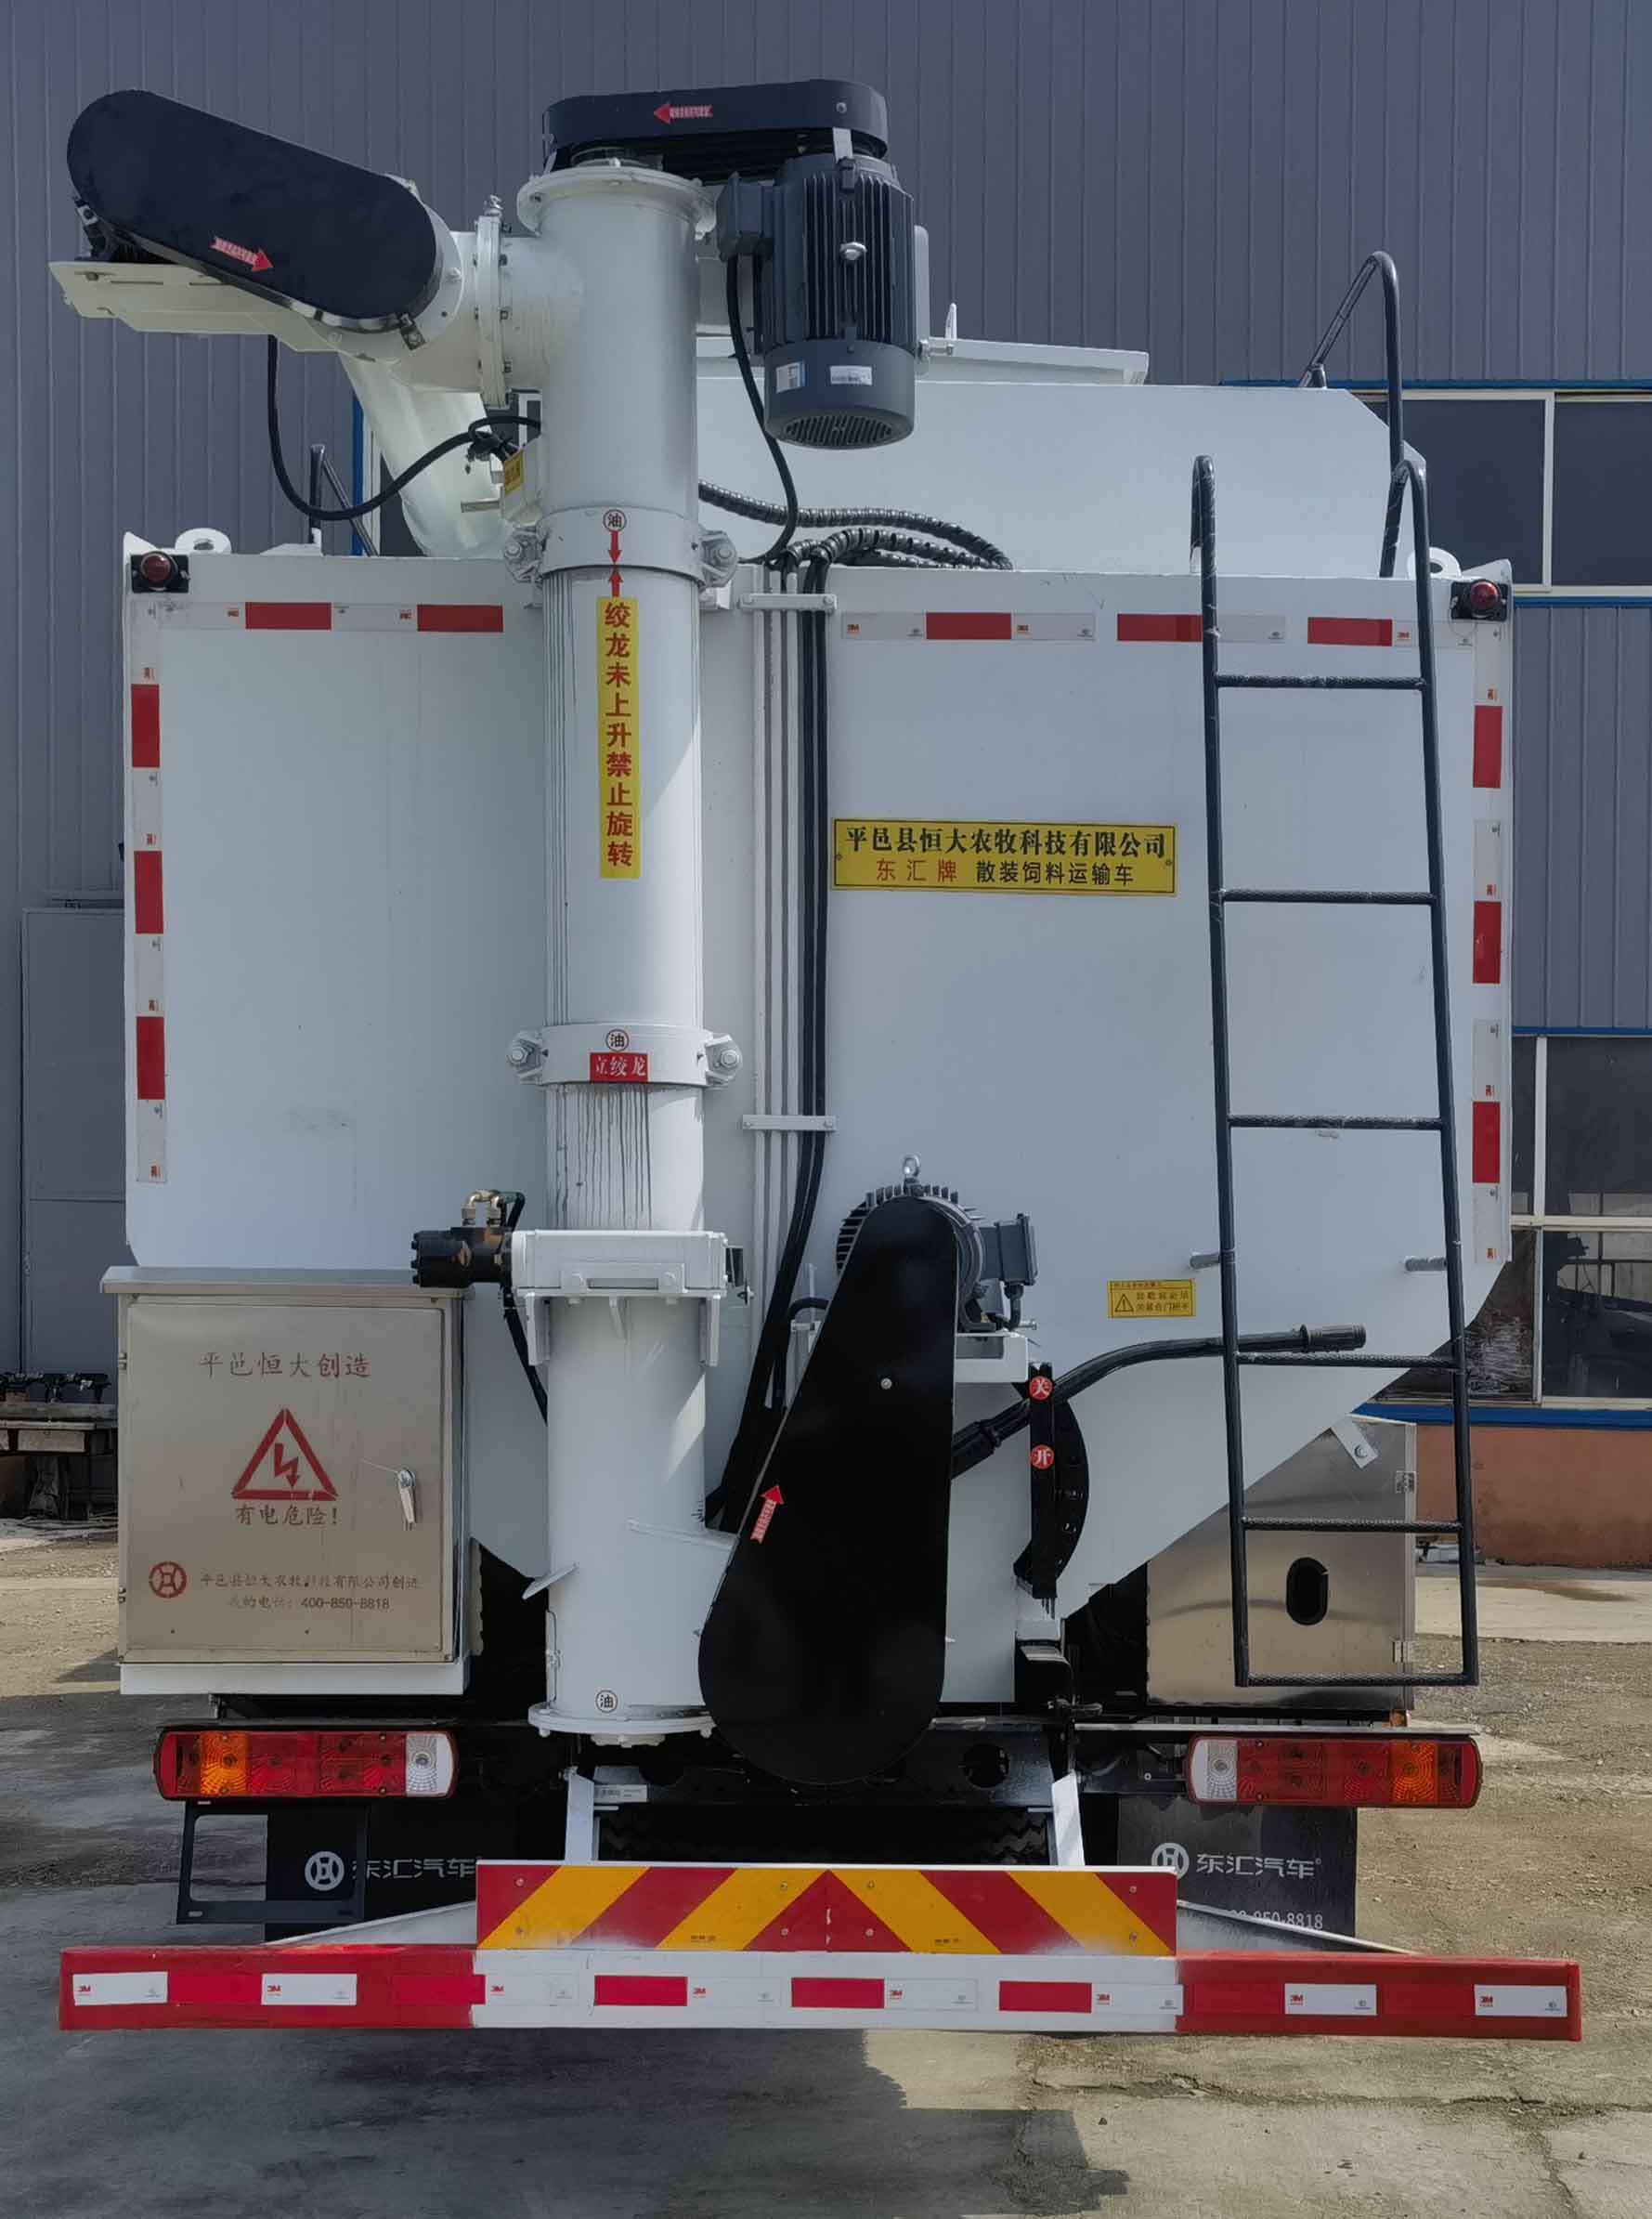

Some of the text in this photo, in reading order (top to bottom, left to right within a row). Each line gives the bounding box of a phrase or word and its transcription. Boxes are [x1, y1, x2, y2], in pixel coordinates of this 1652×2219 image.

[604, 601, 634, 867] 绞龙未上升禁止旋转
[846, 826, 1166, 859] 平邑县恒大农牧科技有限公司
[876, 857, 1134, 887] 东汇牌 散装饲料运输车
[199, 1351, 371, 1378] 平邑恒大创造
[1196, 1853, 1315, 1879] 东汇汽车
